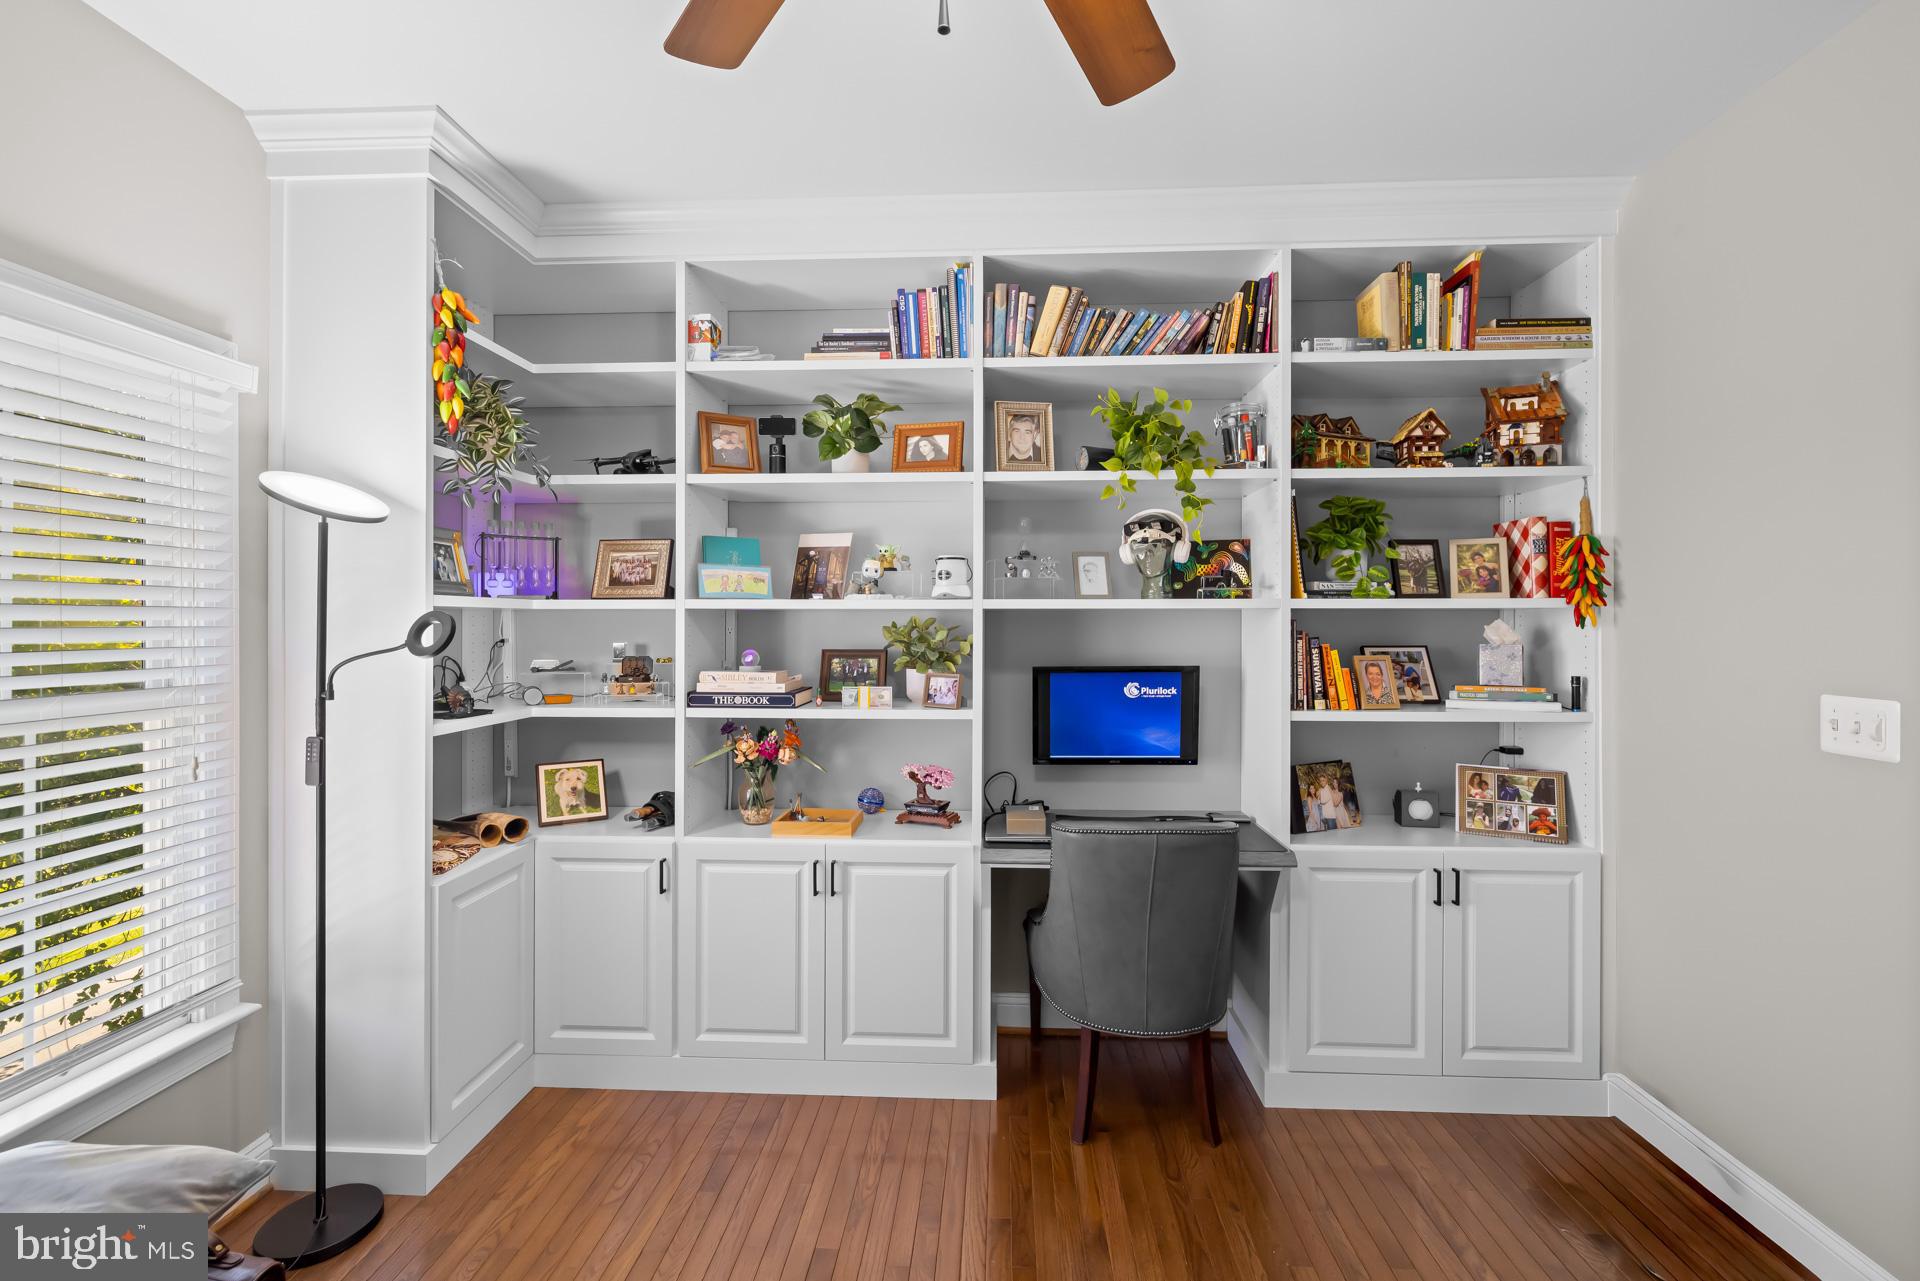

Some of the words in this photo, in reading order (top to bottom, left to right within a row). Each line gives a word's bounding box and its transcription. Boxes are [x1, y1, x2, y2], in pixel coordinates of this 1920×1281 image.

[1311, 648, 1322, 693] SURVIVAL
[712, 696, 735, 705] THE
[741, 696, 770, 705] BOOK
